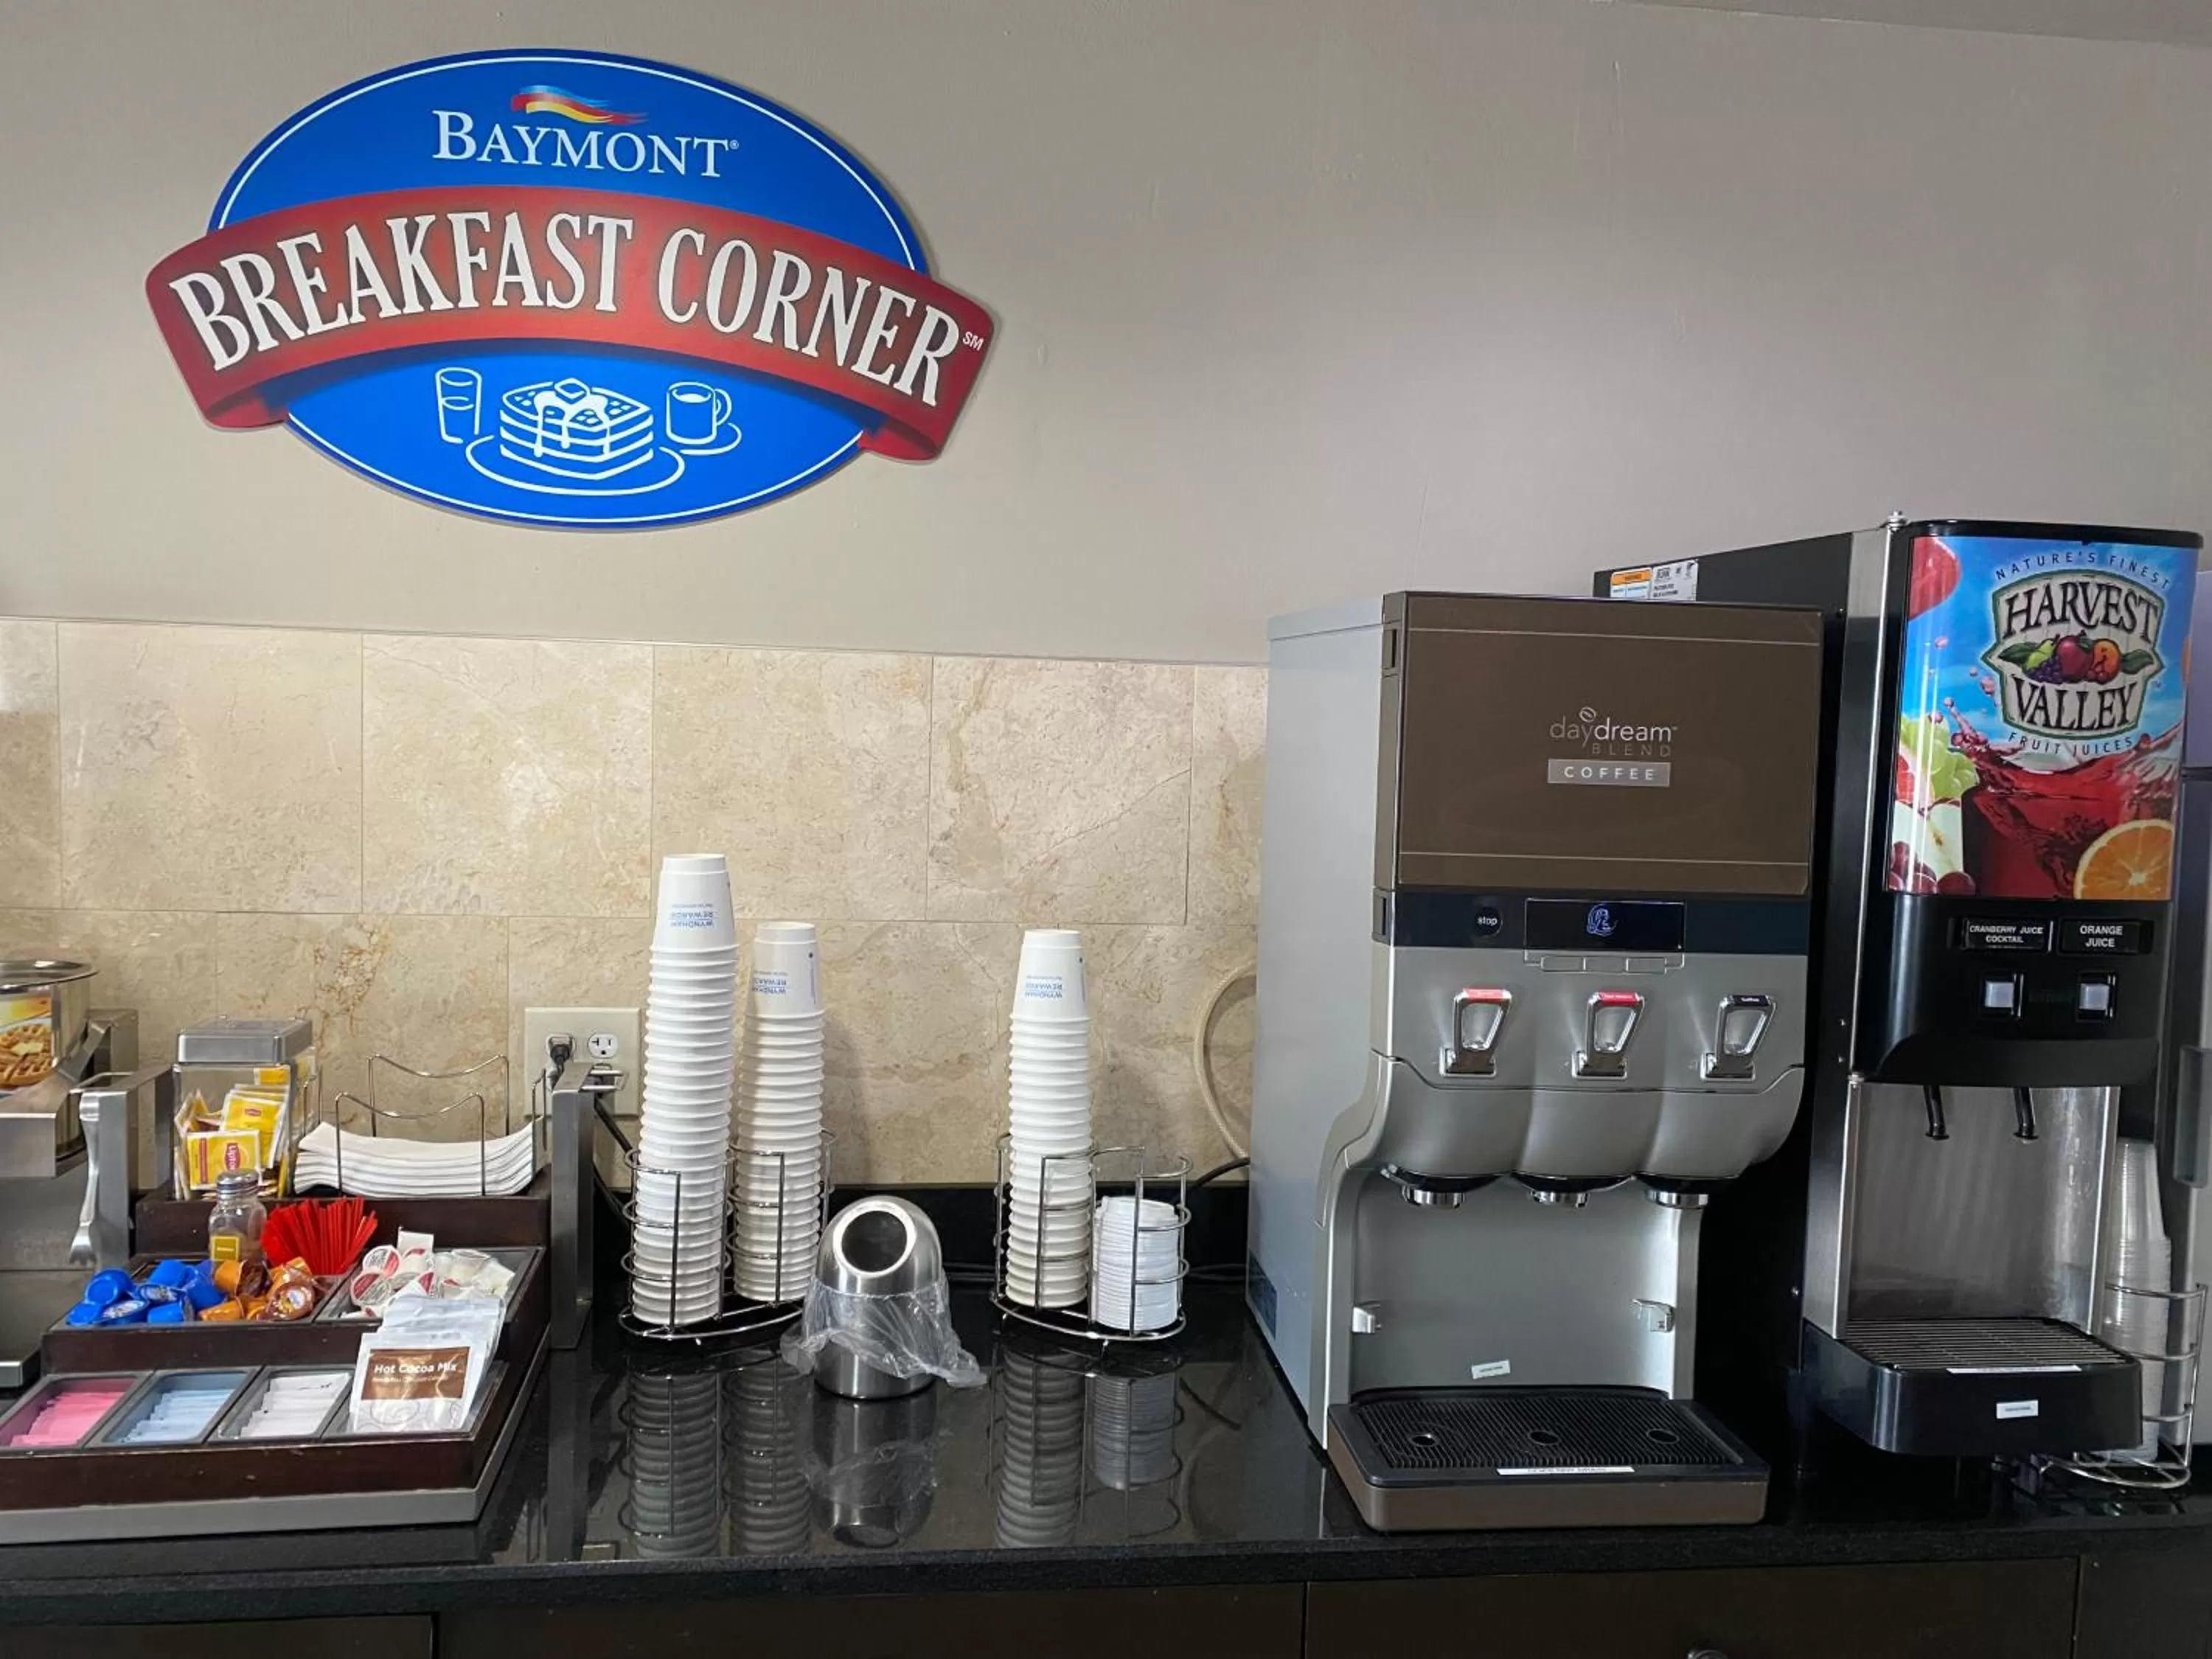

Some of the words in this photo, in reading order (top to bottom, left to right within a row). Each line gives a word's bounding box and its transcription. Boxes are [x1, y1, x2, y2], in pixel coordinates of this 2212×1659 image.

[433, 110, 728, 178] BAYMONT
[169, 211, 633, 372] BREAKFAST
[658, 228, 962, 406] CORNER
[1996, 551, 2096, 580] NATURE'S
[2110, 555, 2170, 589] FINEST
[2002, 580, 2160, 643] HARVEST
[2011, 673, 2138, 731] VALLEY
[1549, 715, 1672, 748] daydream
[1592, 742, 1671, 757] BLEND
[2009, 732, 2060, 754] FRUIT
[2073, 737, 2133, 756] JUICES
[1564, 766, 1655, 781] COFFEE
[1477, 916, 1498, 927] stop
[1969, 925, 2017, 934] CRANBERRY
[2020, 926, 2044, 934] JUICE
[2079, 925, 2124, 936] ORANGE
[1986, 936, 2024, 944] COCKTAIL
[2085, 938, 2115, 947] JUICE
[374, 1364, 396, 1374] Hot
[399, 1364, 434, 1374] Cocoa
[437, 1362, 458, 1371] Mix
